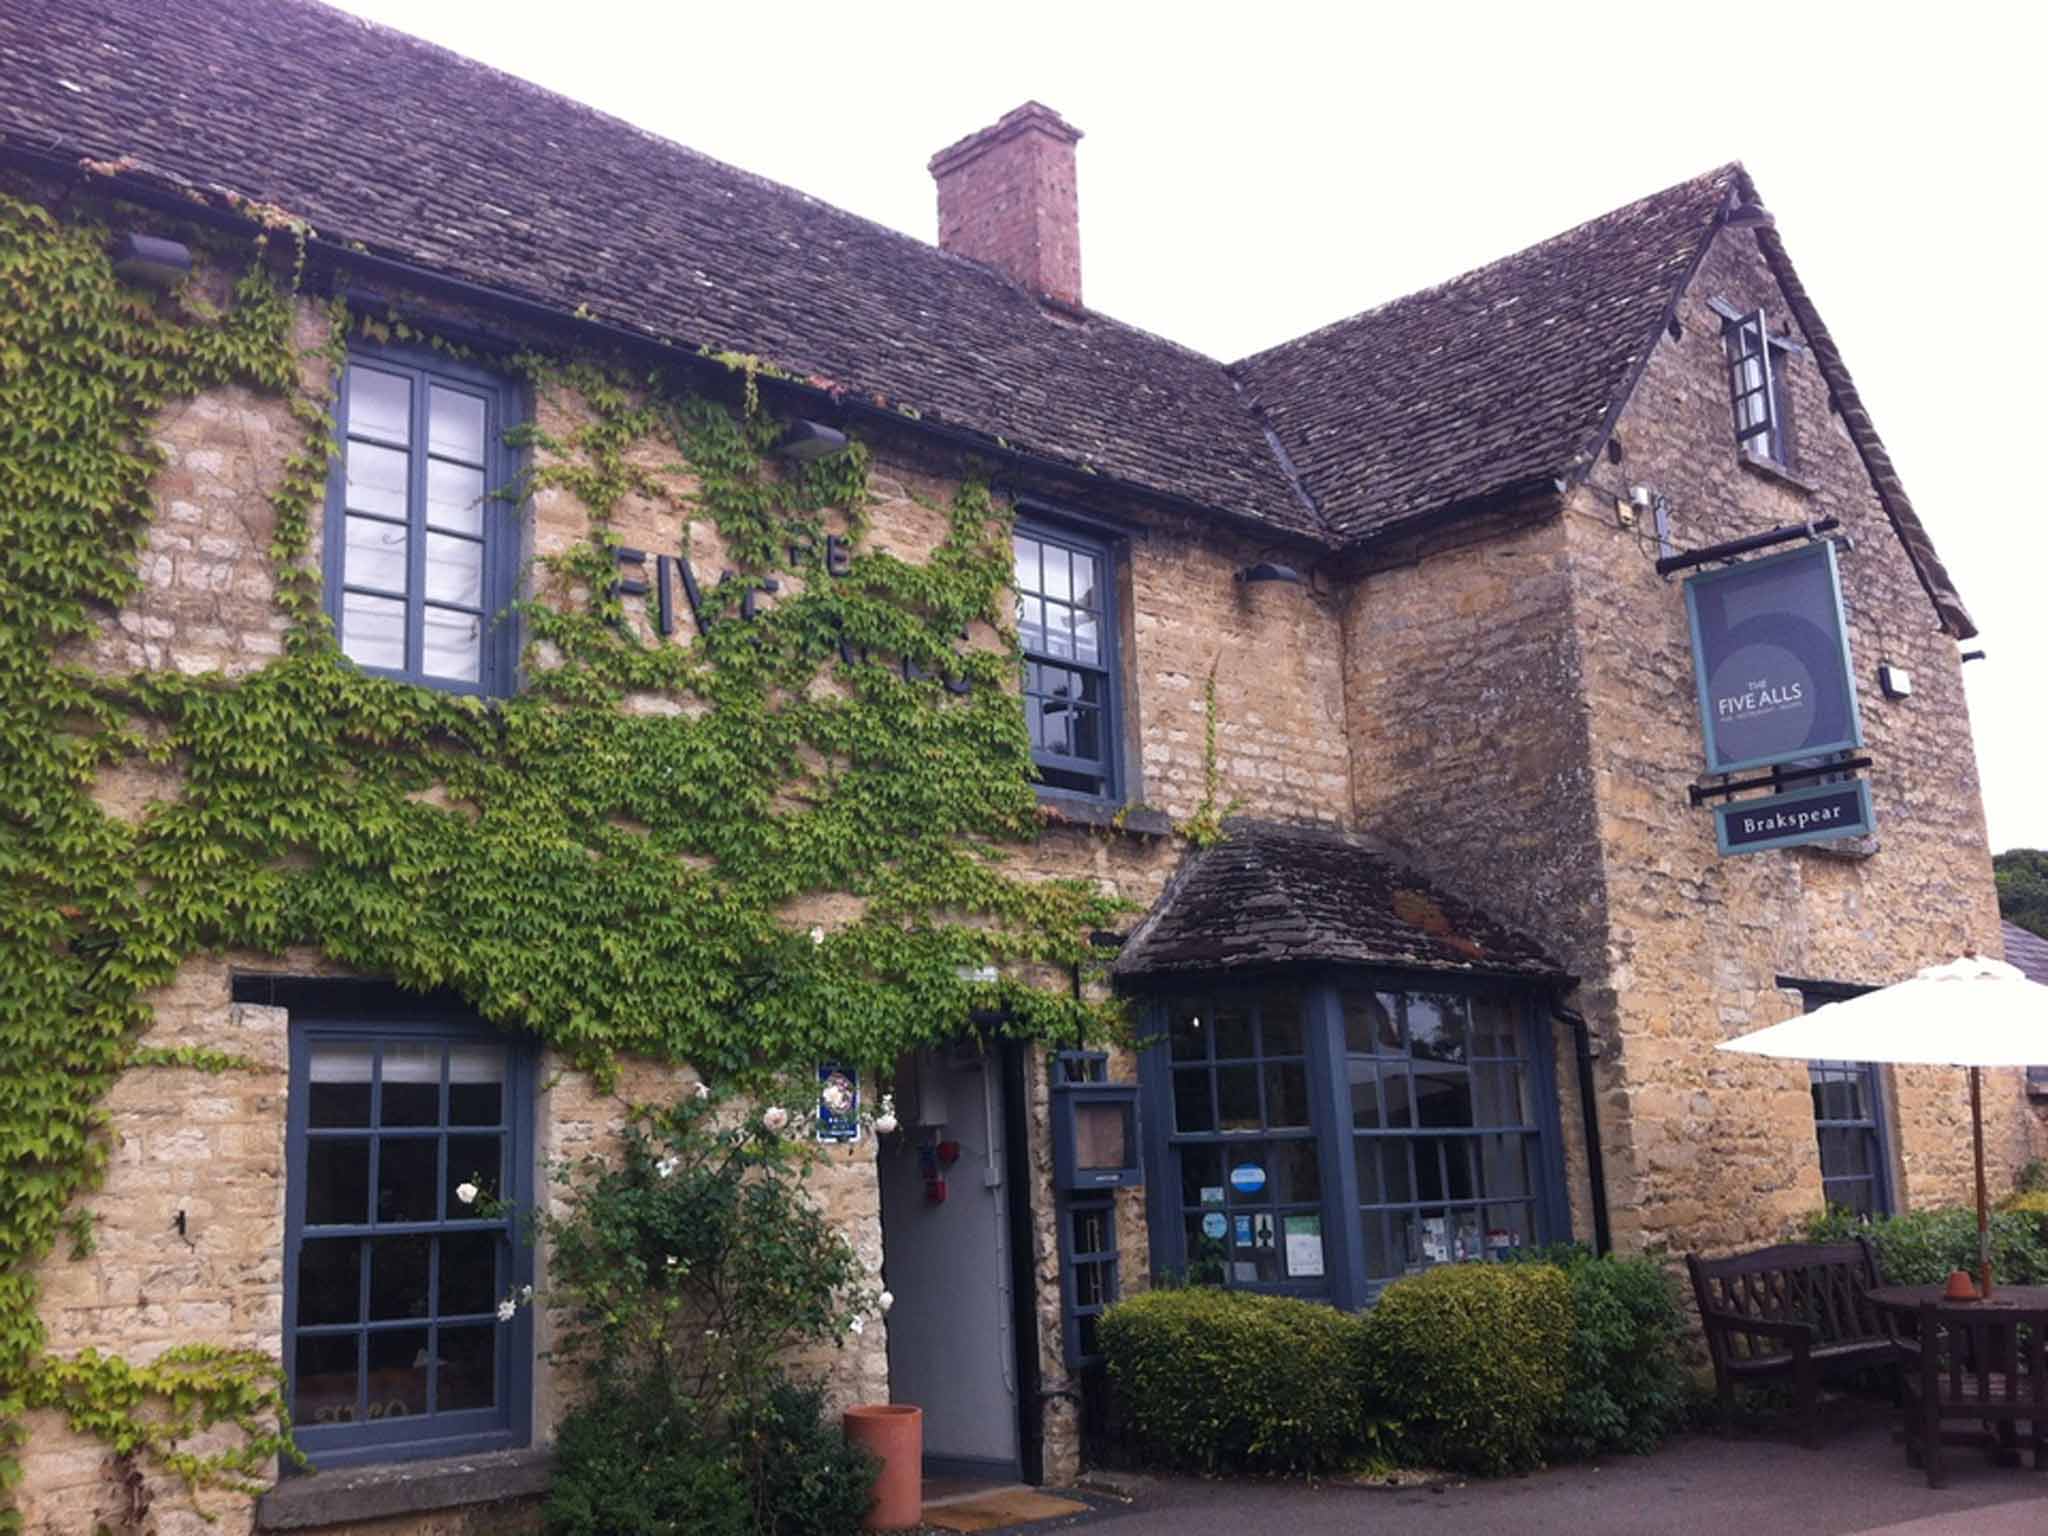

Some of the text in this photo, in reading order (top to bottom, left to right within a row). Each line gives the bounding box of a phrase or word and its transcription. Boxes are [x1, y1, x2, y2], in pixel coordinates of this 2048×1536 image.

[1719, 692, 1756, 716] FIVE
[1759, 682, 1803, 706] ALLS
[1743, 806, 1841, 833] Brakspear
